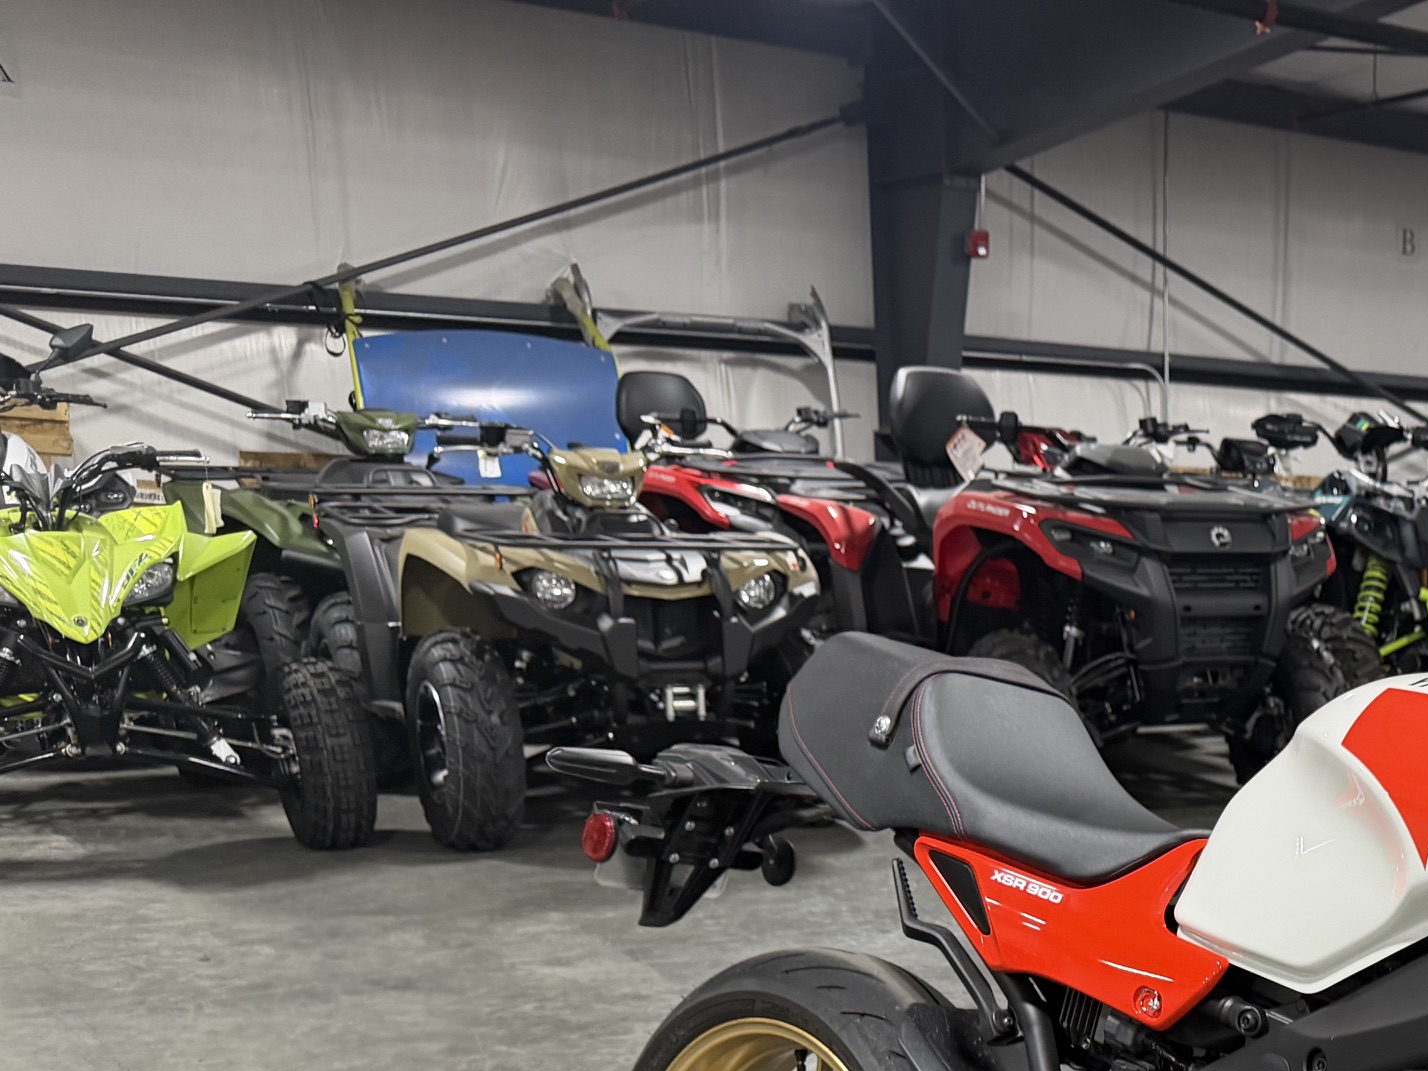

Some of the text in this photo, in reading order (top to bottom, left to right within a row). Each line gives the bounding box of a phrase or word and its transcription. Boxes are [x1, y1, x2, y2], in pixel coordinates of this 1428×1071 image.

[1402, 228, 1415, 255] B
[990, 870, 1064, 905] XSR 900
